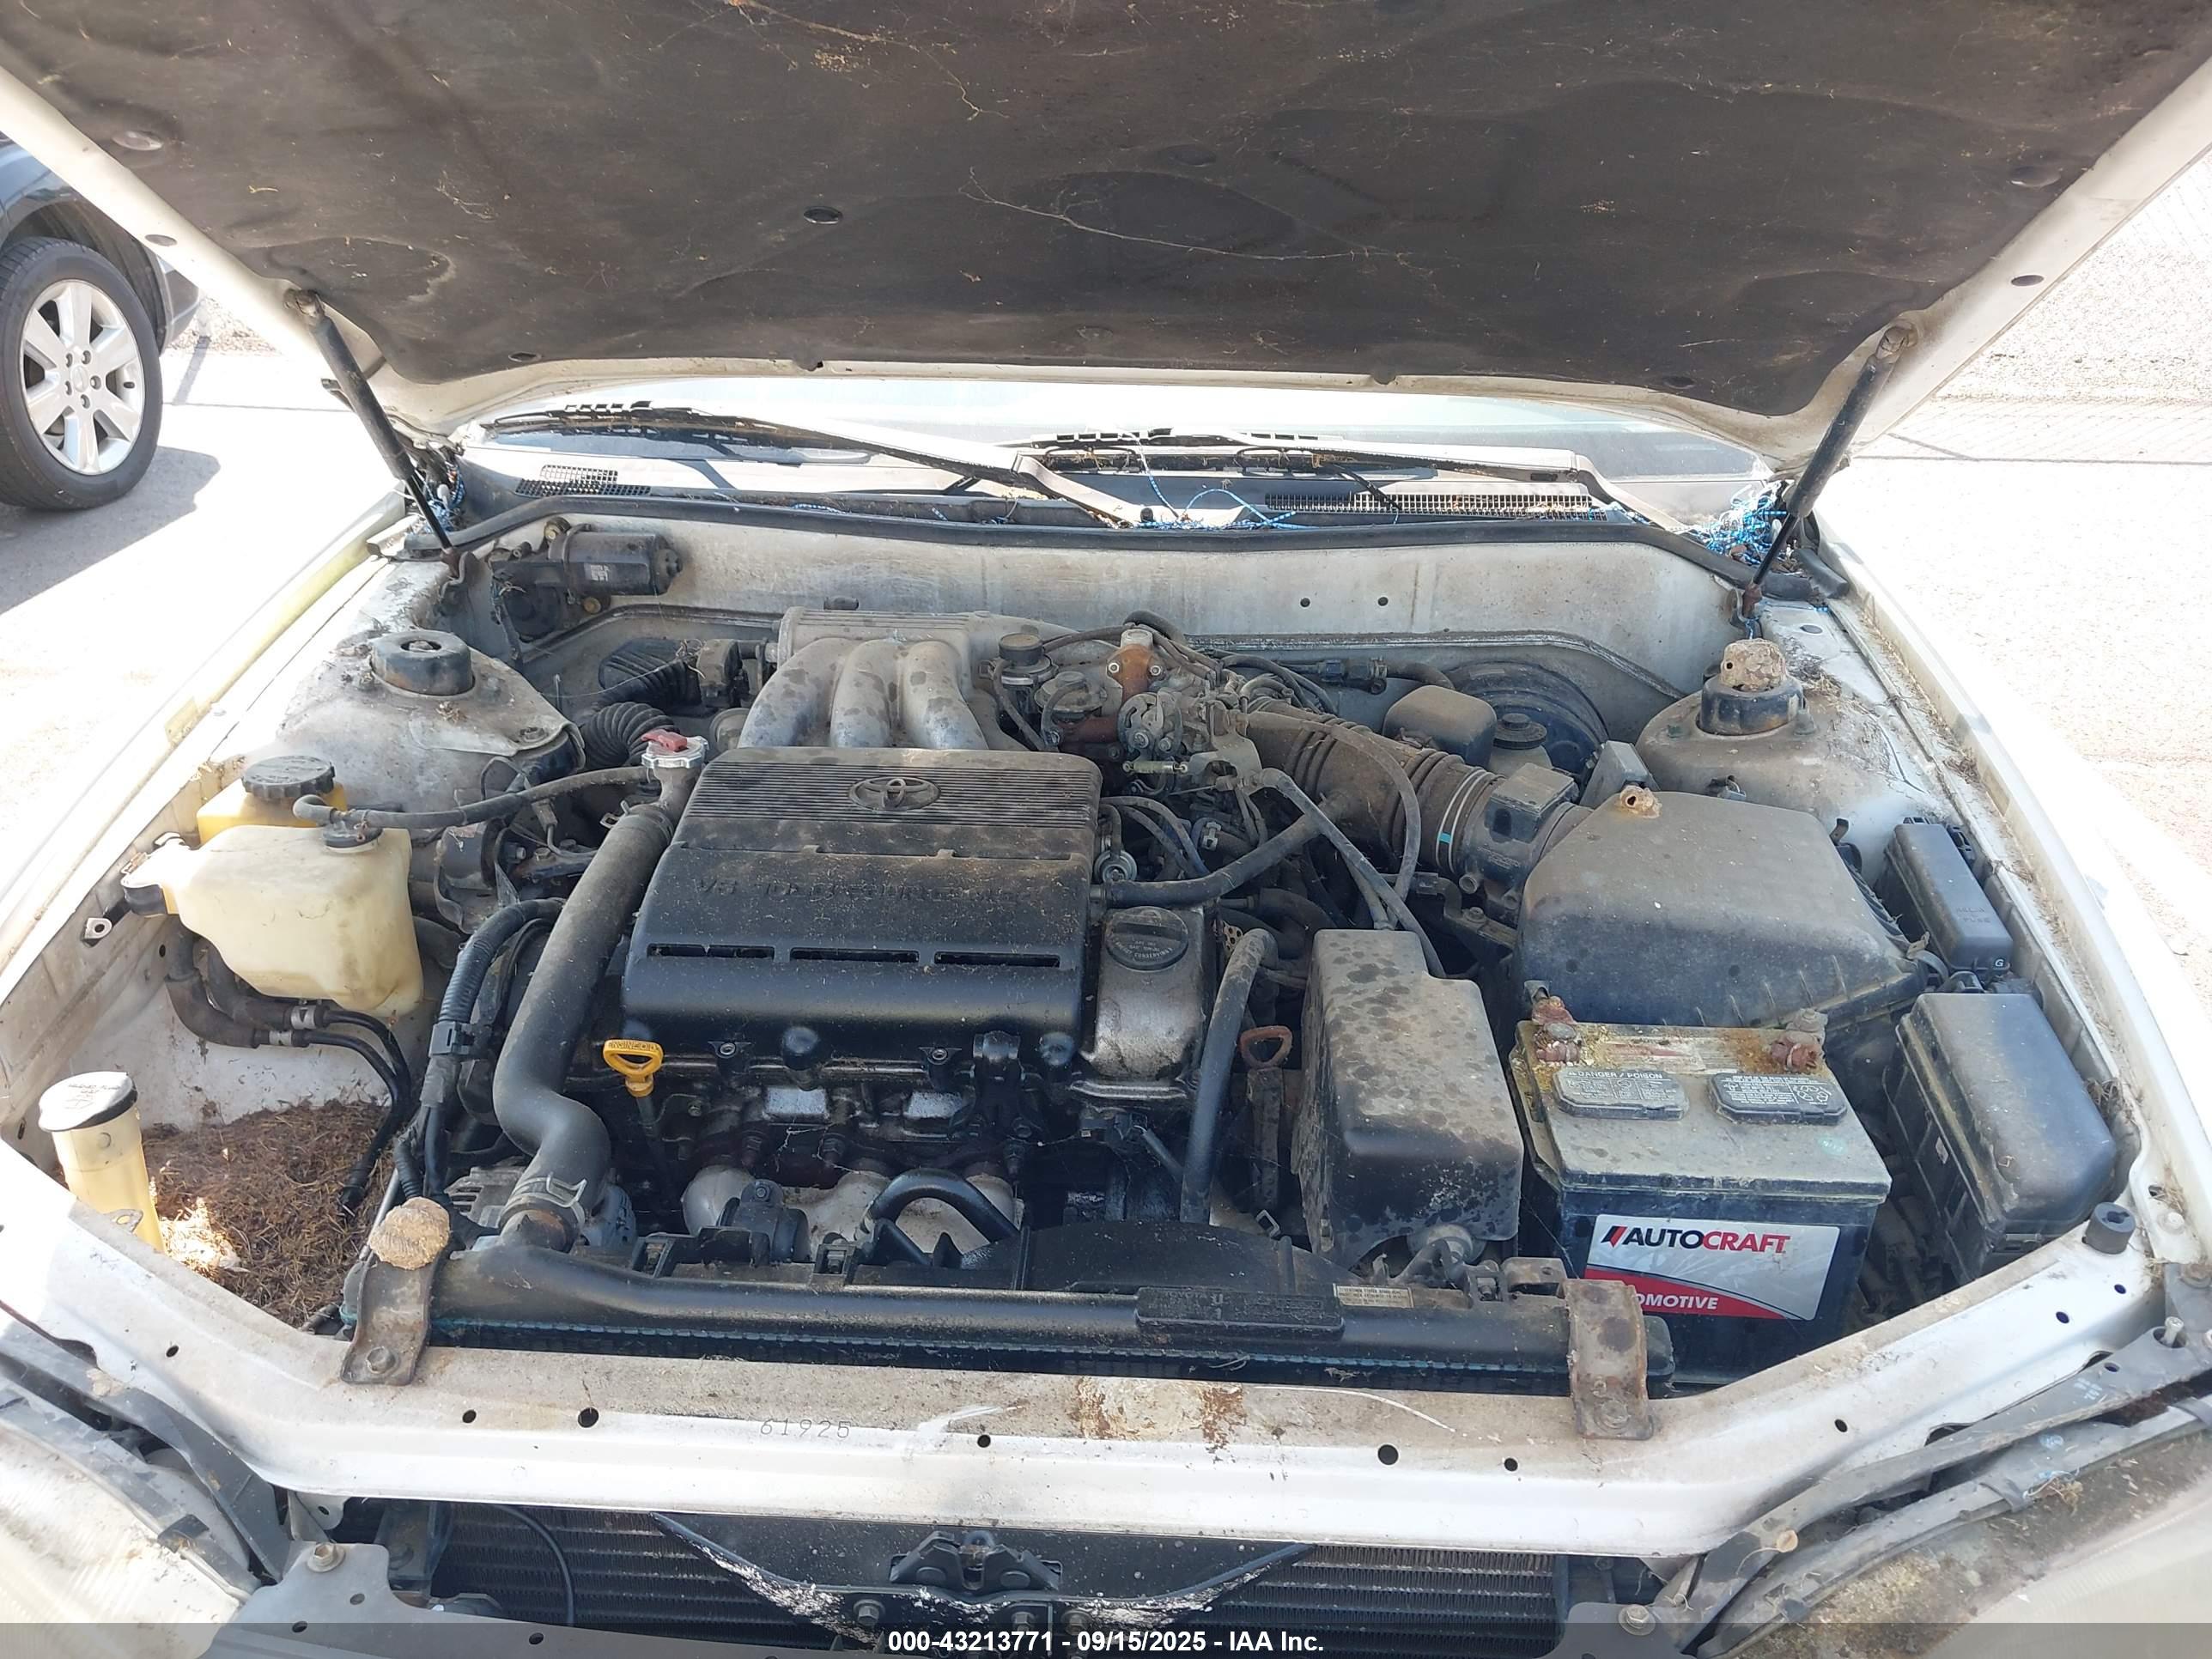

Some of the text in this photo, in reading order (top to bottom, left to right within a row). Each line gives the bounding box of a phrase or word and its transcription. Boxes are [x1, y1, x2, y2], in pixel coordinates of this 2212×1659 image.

[1995, 958, 2004, 967] G
[1624, 1228, 1790, 1253] AUTOCRAFT
[1636, 1293, 1718, 1310] OMOTIVE
[760, 1418, 851, 1439] 61925
